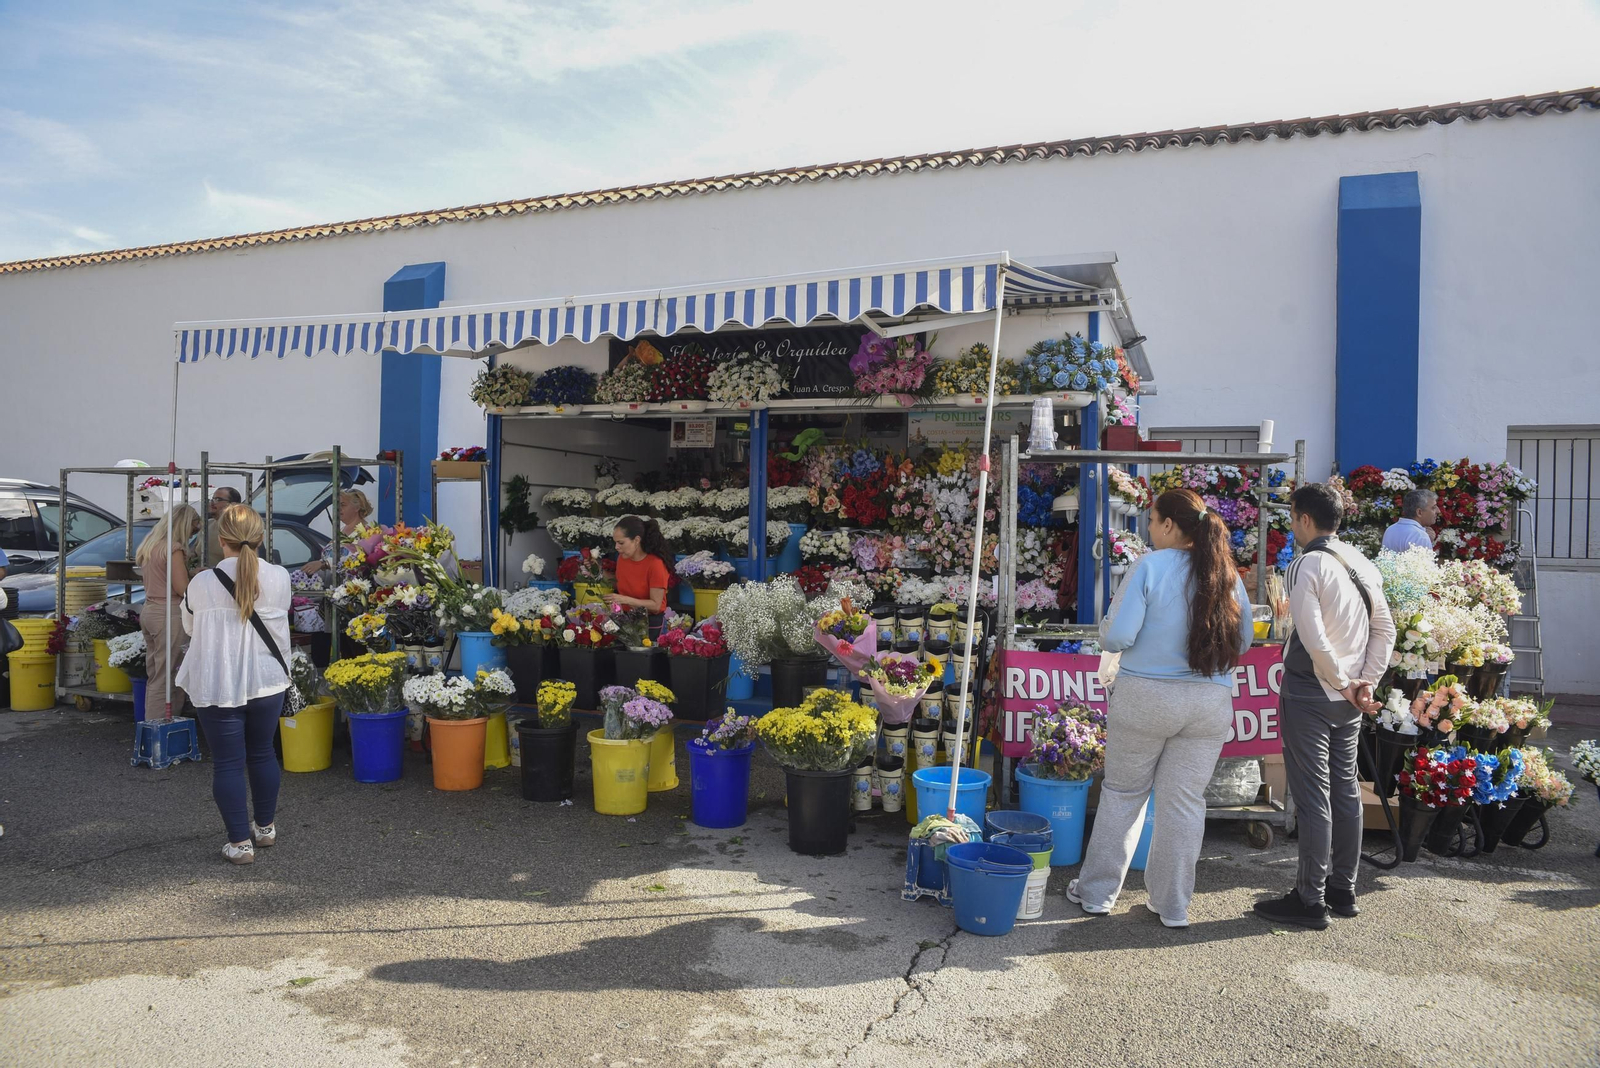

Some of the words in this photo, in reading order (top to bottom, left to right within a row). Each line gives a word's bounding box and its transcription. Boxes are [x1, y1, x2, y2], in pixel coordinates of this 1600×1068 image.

[776, 339, 851, 363] Orquídea
[792, 385, 811, 394] Juan
[812, 385, 821, 393] A.
[823, 384, 850, 394] Crespo
[1003, 667, 1108, 702] RDINE
